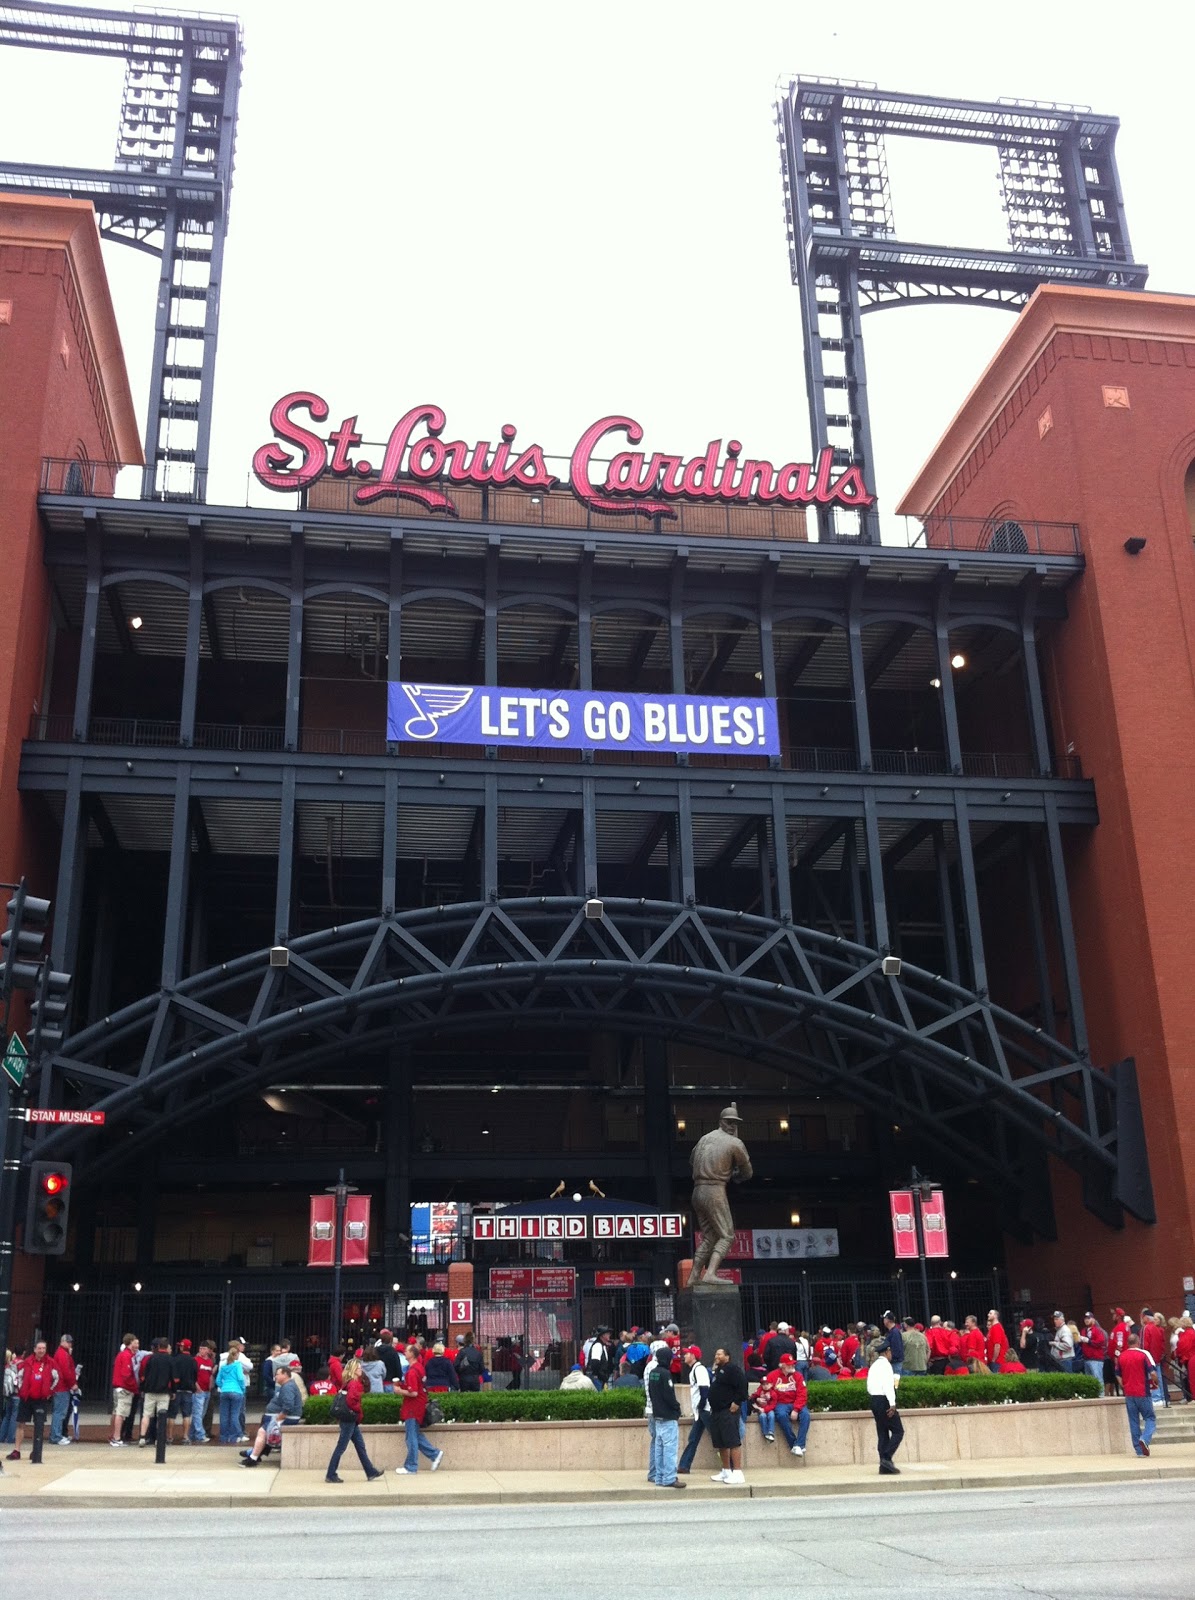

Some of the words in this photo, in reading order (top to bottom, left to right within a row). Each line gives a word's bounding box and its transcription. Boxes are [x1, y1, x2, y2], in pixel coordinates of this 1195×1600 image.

[252, 391, 372, 492] St.
[353, 404, 557, 518] Louis
[569, 415, 878, 520] Cardinals
[480, 695, 570, 739] LET'S
[583, 700, 631, 742] GO
[643, 700, 766, 746] BLUES!
[31, 1110, 56, 1121] STAN
[59, 1111, 94, 1123] MUSIAL
[478, 1219, 584, 1237] THIRD
[597, 1217, 676, 1236] BASE
[457, 1302, 466, 1320] 3
